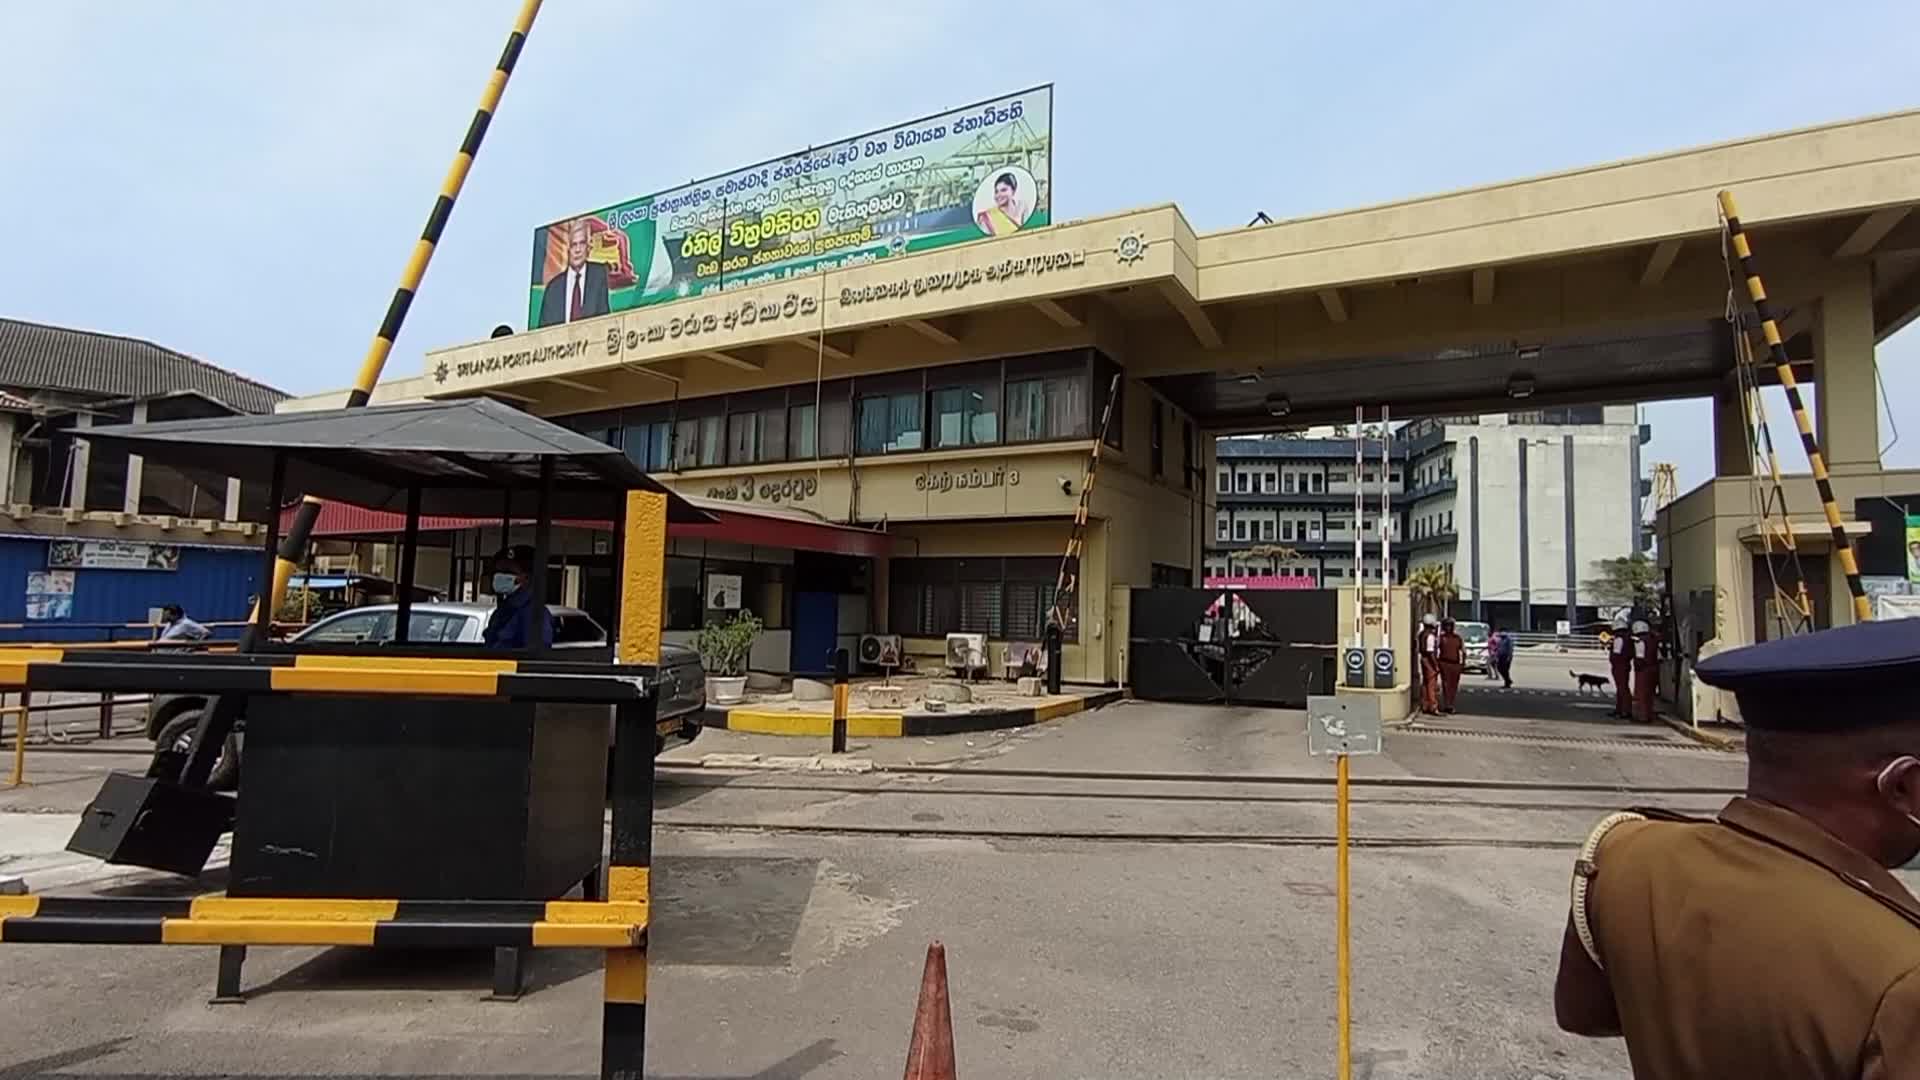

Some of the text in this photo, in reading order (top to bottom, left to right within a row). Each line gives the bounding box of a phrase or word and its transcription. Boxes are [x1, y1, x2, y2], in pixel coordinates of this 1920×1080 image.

[836, 146, 858, 168] අට
[864, 141, 887, 158] වන
[894, 126, 946, 150] විධායක
[953, 102, 1023, 134] ජනාධිපති
[681, 232, 723, 257] රනිල්
[730, 208, 820, 248] වික්‍රමසිංහ
[625, 325, 665, 349] ලංකා
[670, 314, 718, 338] වරාය
[469, 357, 501, 375] LANKA
[503, 351, 531, 368] PORTS
[532, 340, 588, 365] AUTHORITY
[742, 477, 754, 501] 3
[956, 466, 1005, 488] நம்பர்
[1009, 470, 1020, 486] 3
